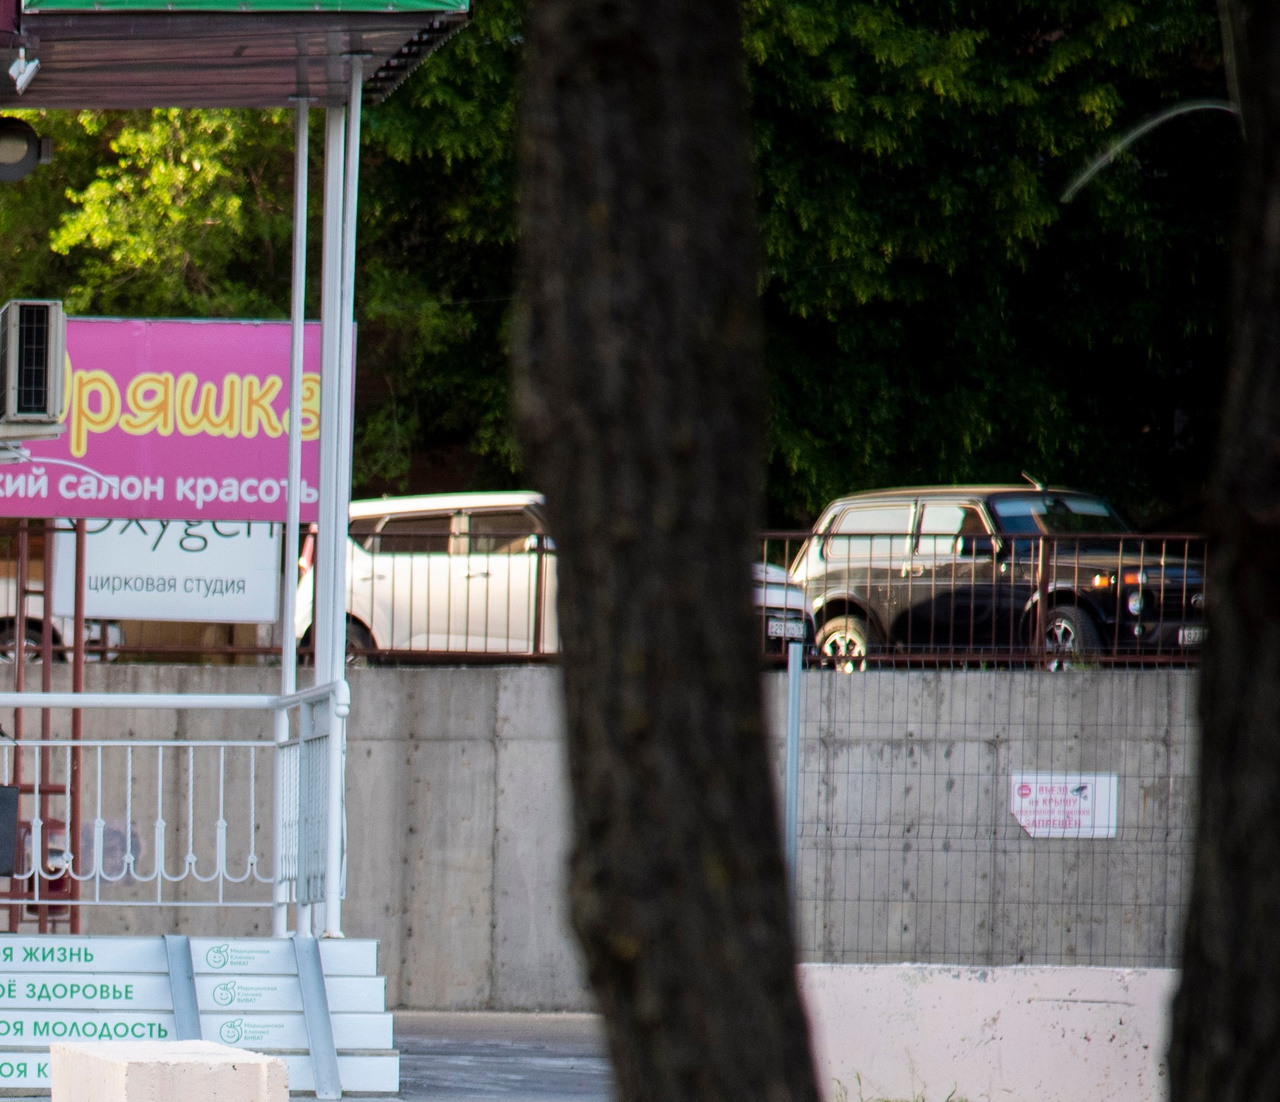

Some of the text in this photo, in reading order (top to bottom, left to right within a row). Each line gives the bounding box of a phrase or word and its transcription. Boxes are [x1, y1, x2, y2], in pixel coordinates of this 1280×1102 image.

[57, 474, 165, 501] салон
[87, 575, 246, 598] цирковая студия
[22, 946, 95, 963] ЖИЗНЬ
[25, 983, 134, 1002] ЗДОРОВЬЕ
[32, 1021, 169, 1040] МОЛОДОСТЬ
